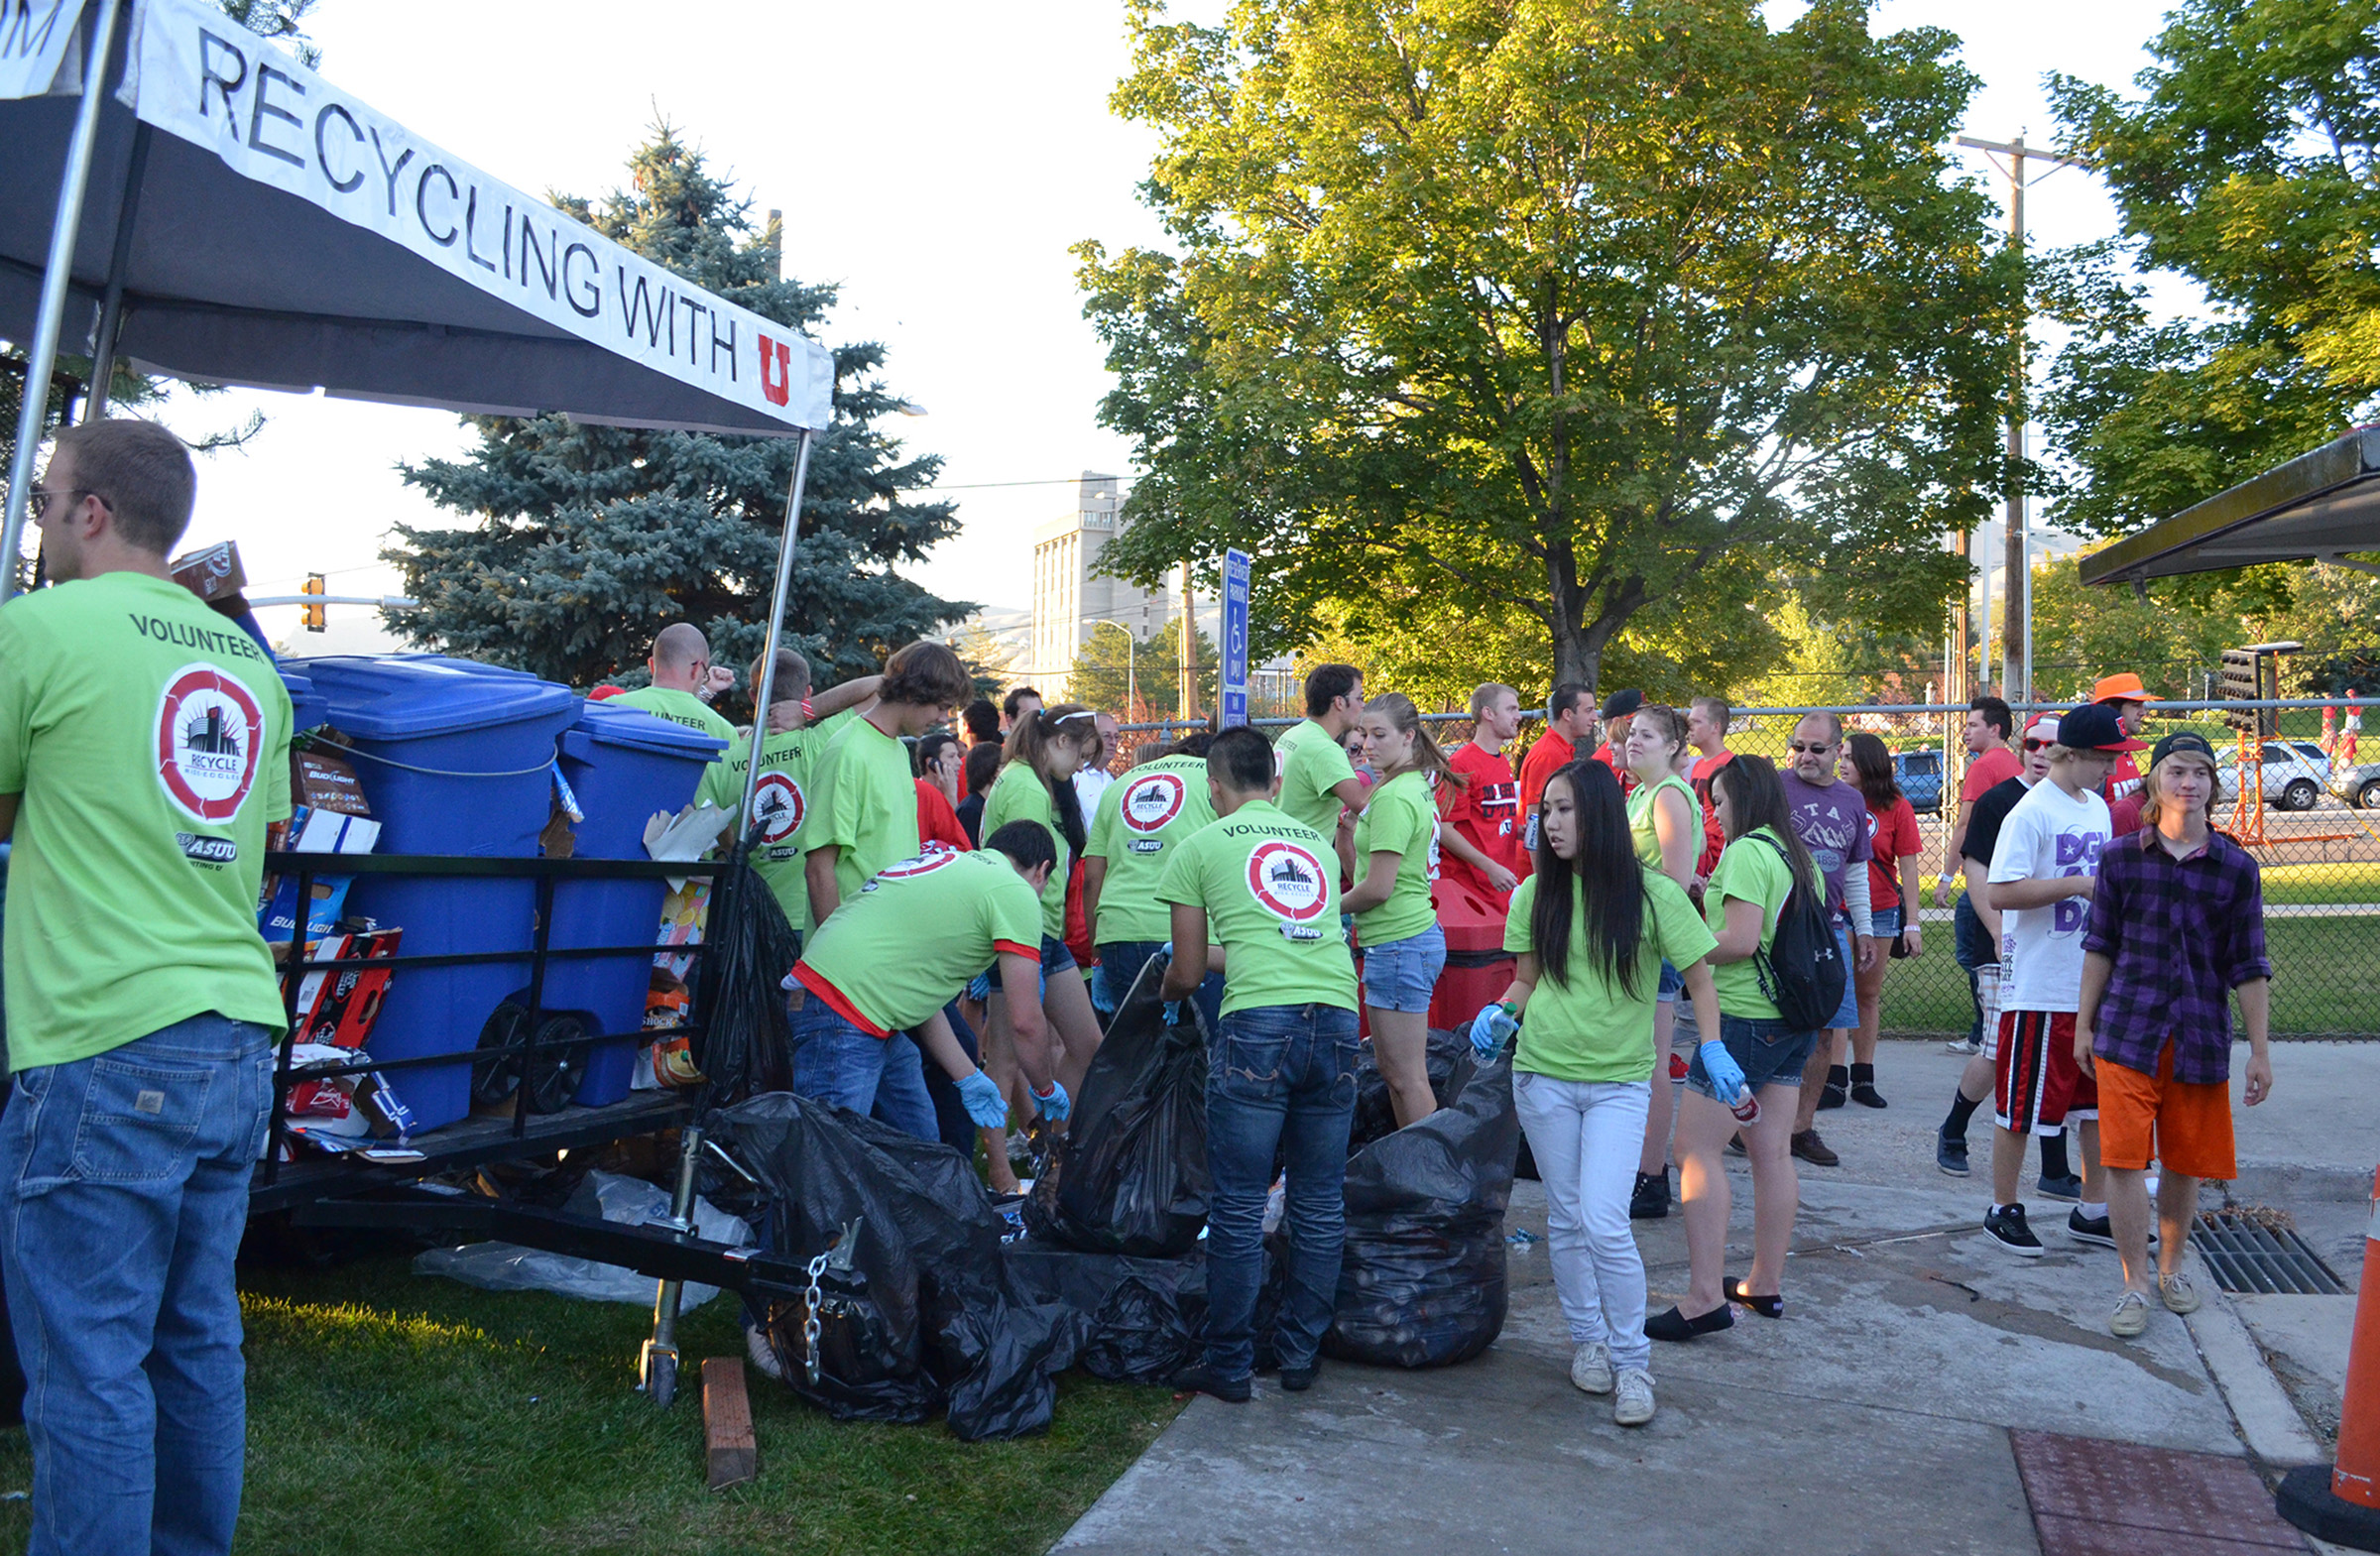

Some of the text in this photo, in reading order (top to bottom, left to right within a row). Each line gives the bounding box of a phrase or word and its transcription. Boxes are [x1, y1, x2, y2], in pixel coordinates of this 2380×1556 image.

[198, 27, 791, 408] RECYCLING WITH U
[129, 613, 265, 663] VOLUNTEER
[191, 754, 237, 771] RECYCLE
[732, 747, 801, 772] VOUNTEER
[1130, 761, 1206, 774] VOLUNTEER
[308, 771, 330, 780] BUD
[1223, 824, 1321, 842] VOLUNTEER
[188, 840, 237, 859] ASUU
[1137, 841, 1161, 850] ASUU
[1277, 883, 1310, 893] RECYCLE
[1293, 925, 1322, 936] ASUU
